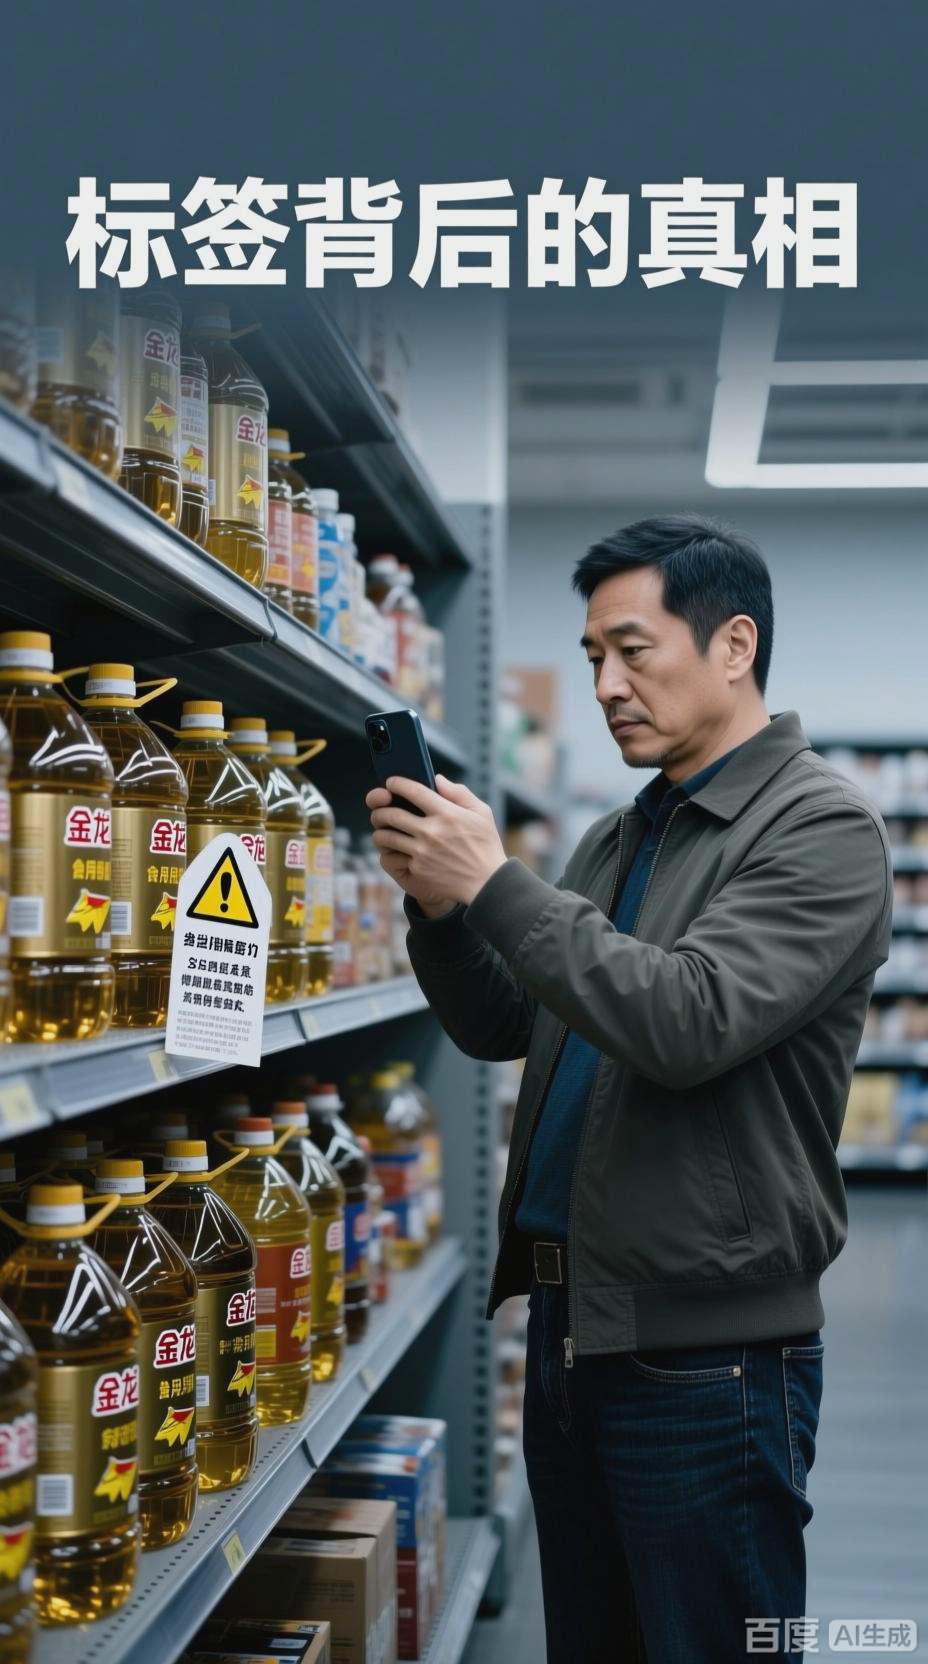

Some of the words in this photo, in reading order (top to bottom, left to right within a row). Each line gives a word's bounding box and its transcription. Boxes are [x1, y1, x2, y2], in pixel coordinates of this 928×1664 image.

[68, 810, 111, 845] 金龙
[151, 821, 186, 853] 金龙
[155, 1327, 195, 1366] 金龙
[95, 1369, 139, 1412] 金龙
